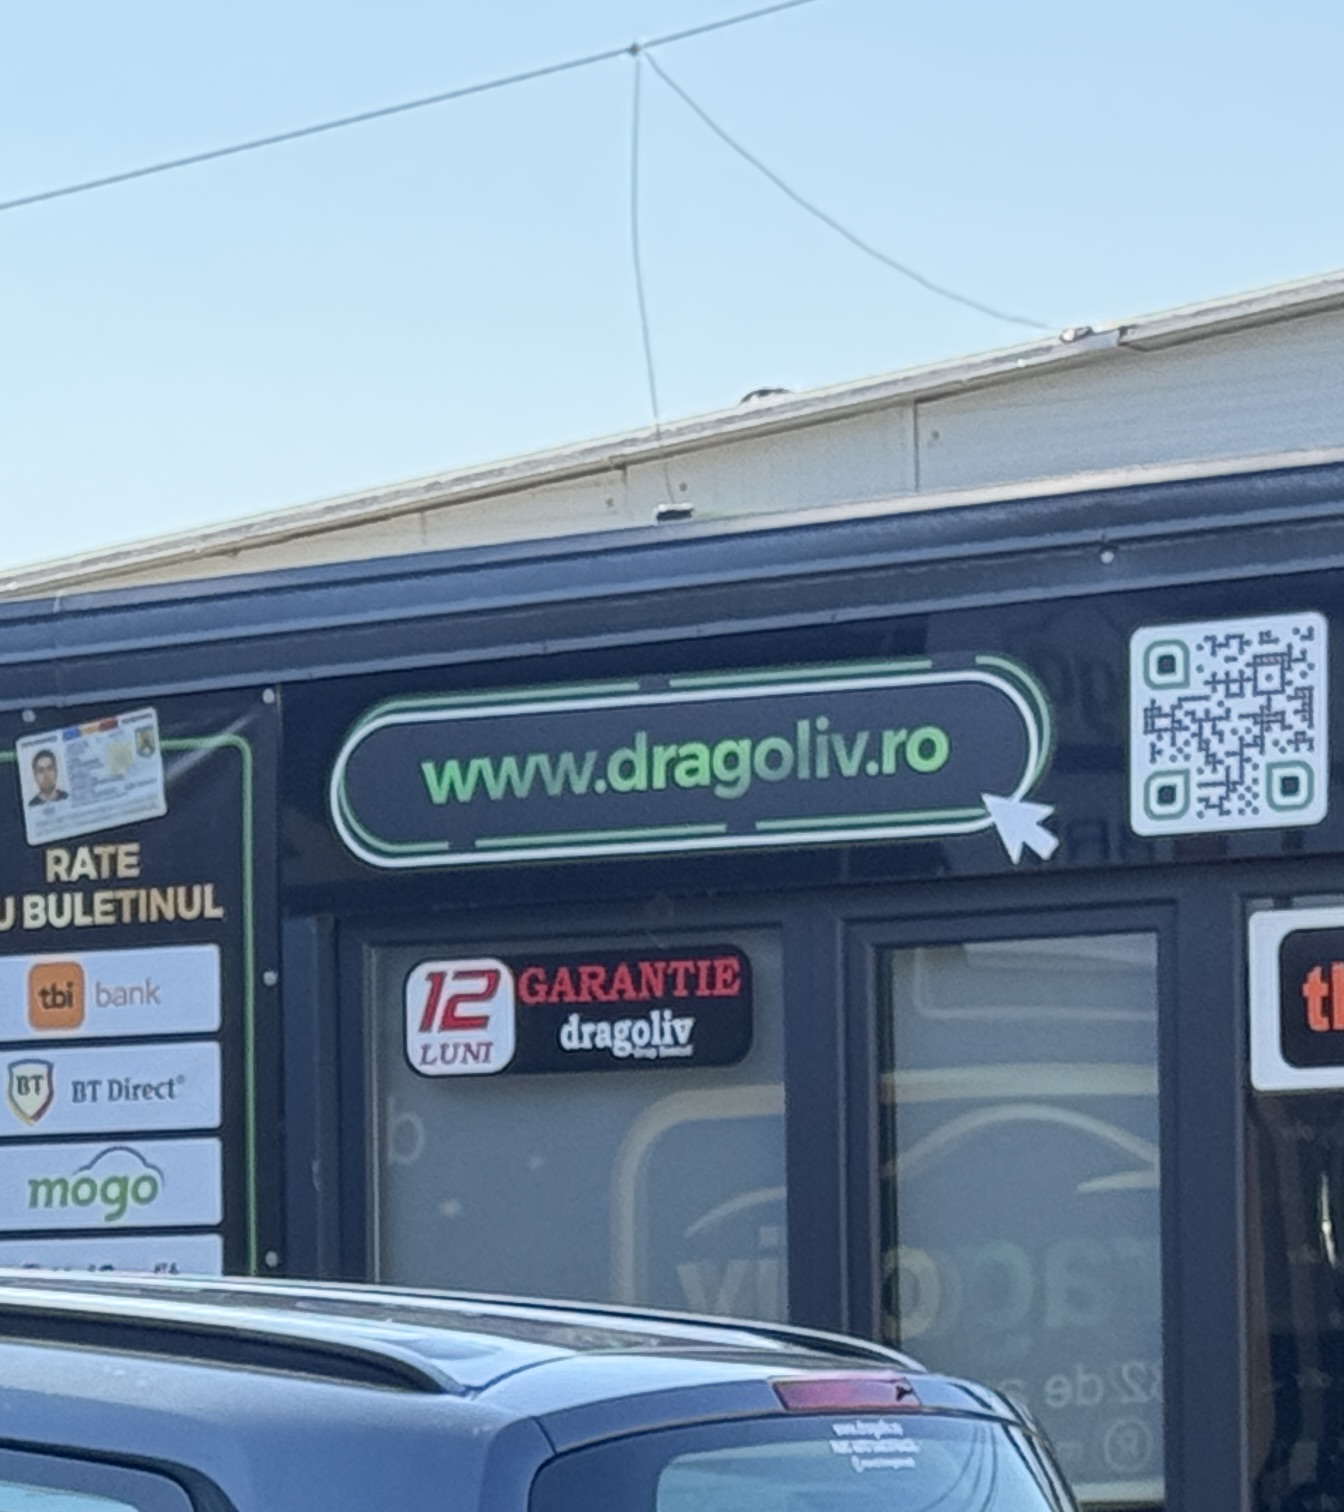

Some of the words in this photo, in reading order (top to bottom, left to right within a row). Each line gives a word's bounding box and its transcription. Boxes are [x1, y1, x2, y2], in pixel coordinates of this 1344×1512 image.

[421, 716, 950, 804] www.dragoliv.ro
[45, 843, 140, 882] RATE
[22, 883, 223, 930] BULETINUL
[38, 984, 73, 1010] tbi
[94, 977, 161, 1008] bank
[418, 970, 501, 1033] 12
[518, 956, 741, 1005] GARANTIE
[419, 1041, 493, 1066] LUNI
[560, 1009, 695, 1058] dragoliv
[16, 1074, 44, 1096] BT
[71, 1080, 101, 1103] BT
[107, 1074, 176, 1101] Direct
[28, 1172, 159, 1222] mogo
